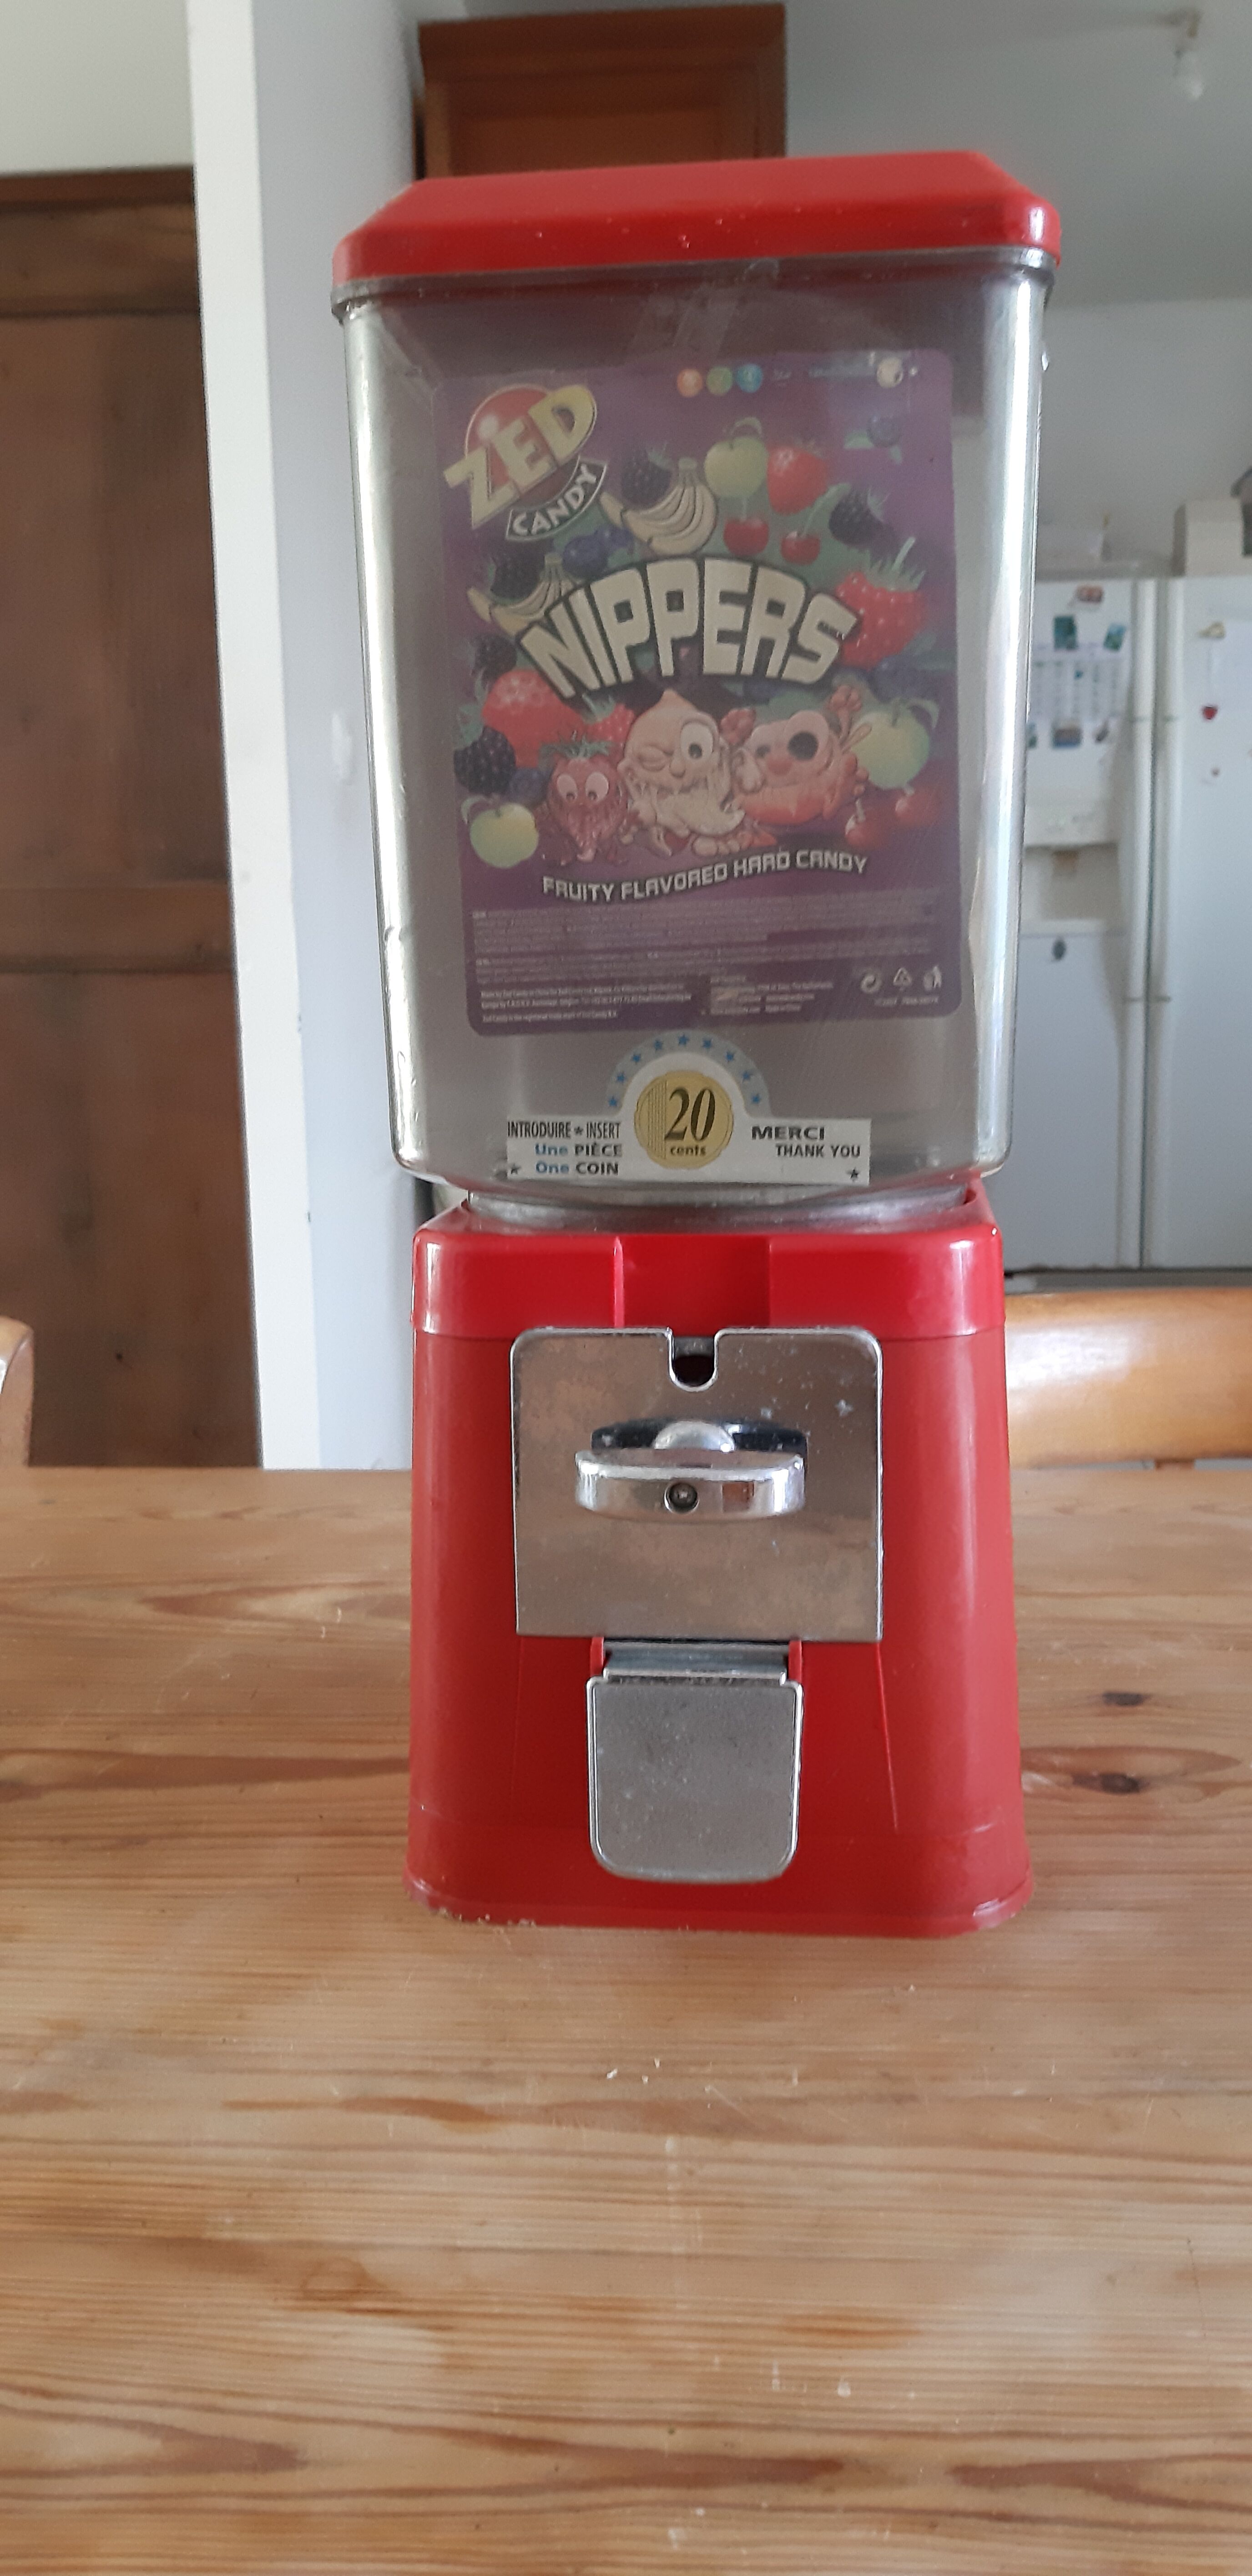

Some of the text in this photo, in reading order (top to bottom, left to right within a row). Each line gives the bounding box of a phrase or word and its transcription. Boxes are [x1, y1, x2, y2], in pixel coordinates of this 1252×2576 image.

[444, 385, 596, 530] ZED
[512, 464, 597, 536] CANDY
[520, 558, 857, 699] NIPPERS
[543, 849, 867, 902] FRUITY FLAVORED HARD CANDY
[664, 1087, 716, 1142] 20
[507, 1121, 621, 1137] INTRODUIRE INSERT
[751, 1125, 825, 1140] MERCI
[535, 1141, 622, 1157] Une PIÈCE
[670, 1145, 707, 1157] cents
[776, 1144, 861, 1158] THANK YOU
[535, 1161, 619, 1175] One COIN
